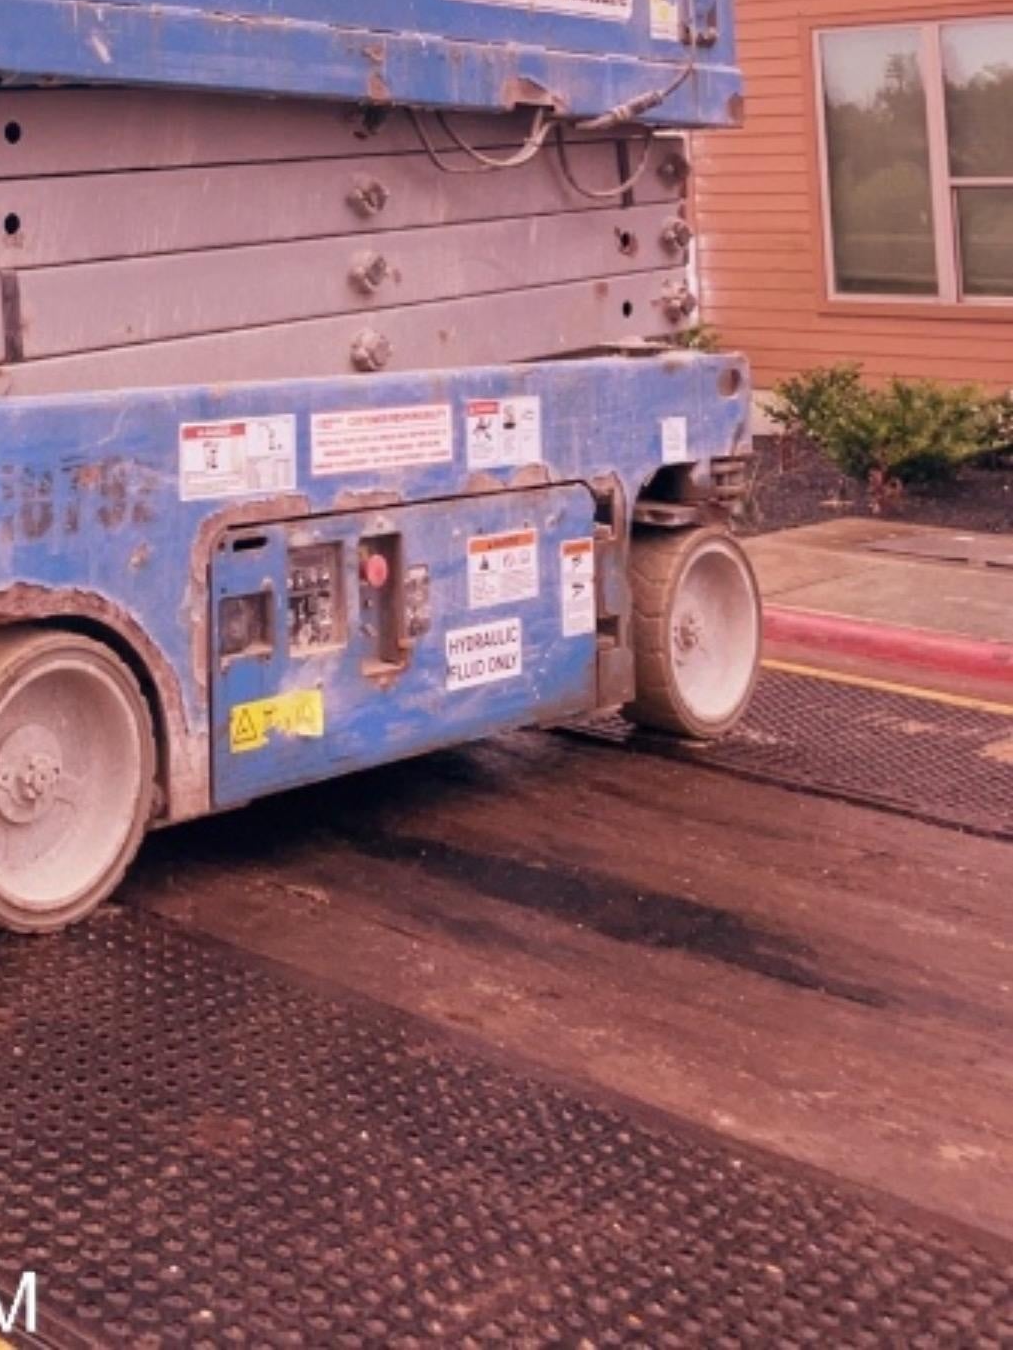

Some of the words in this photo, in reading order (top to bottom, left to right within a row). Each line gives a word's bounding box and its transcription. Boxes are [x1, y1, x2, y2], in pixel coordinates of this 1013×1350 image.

[449, 626, 517, 655] HYDRAULIC
[447, 659, 485, 682] FLUID
[489, 653, 517, 673] ONLY
